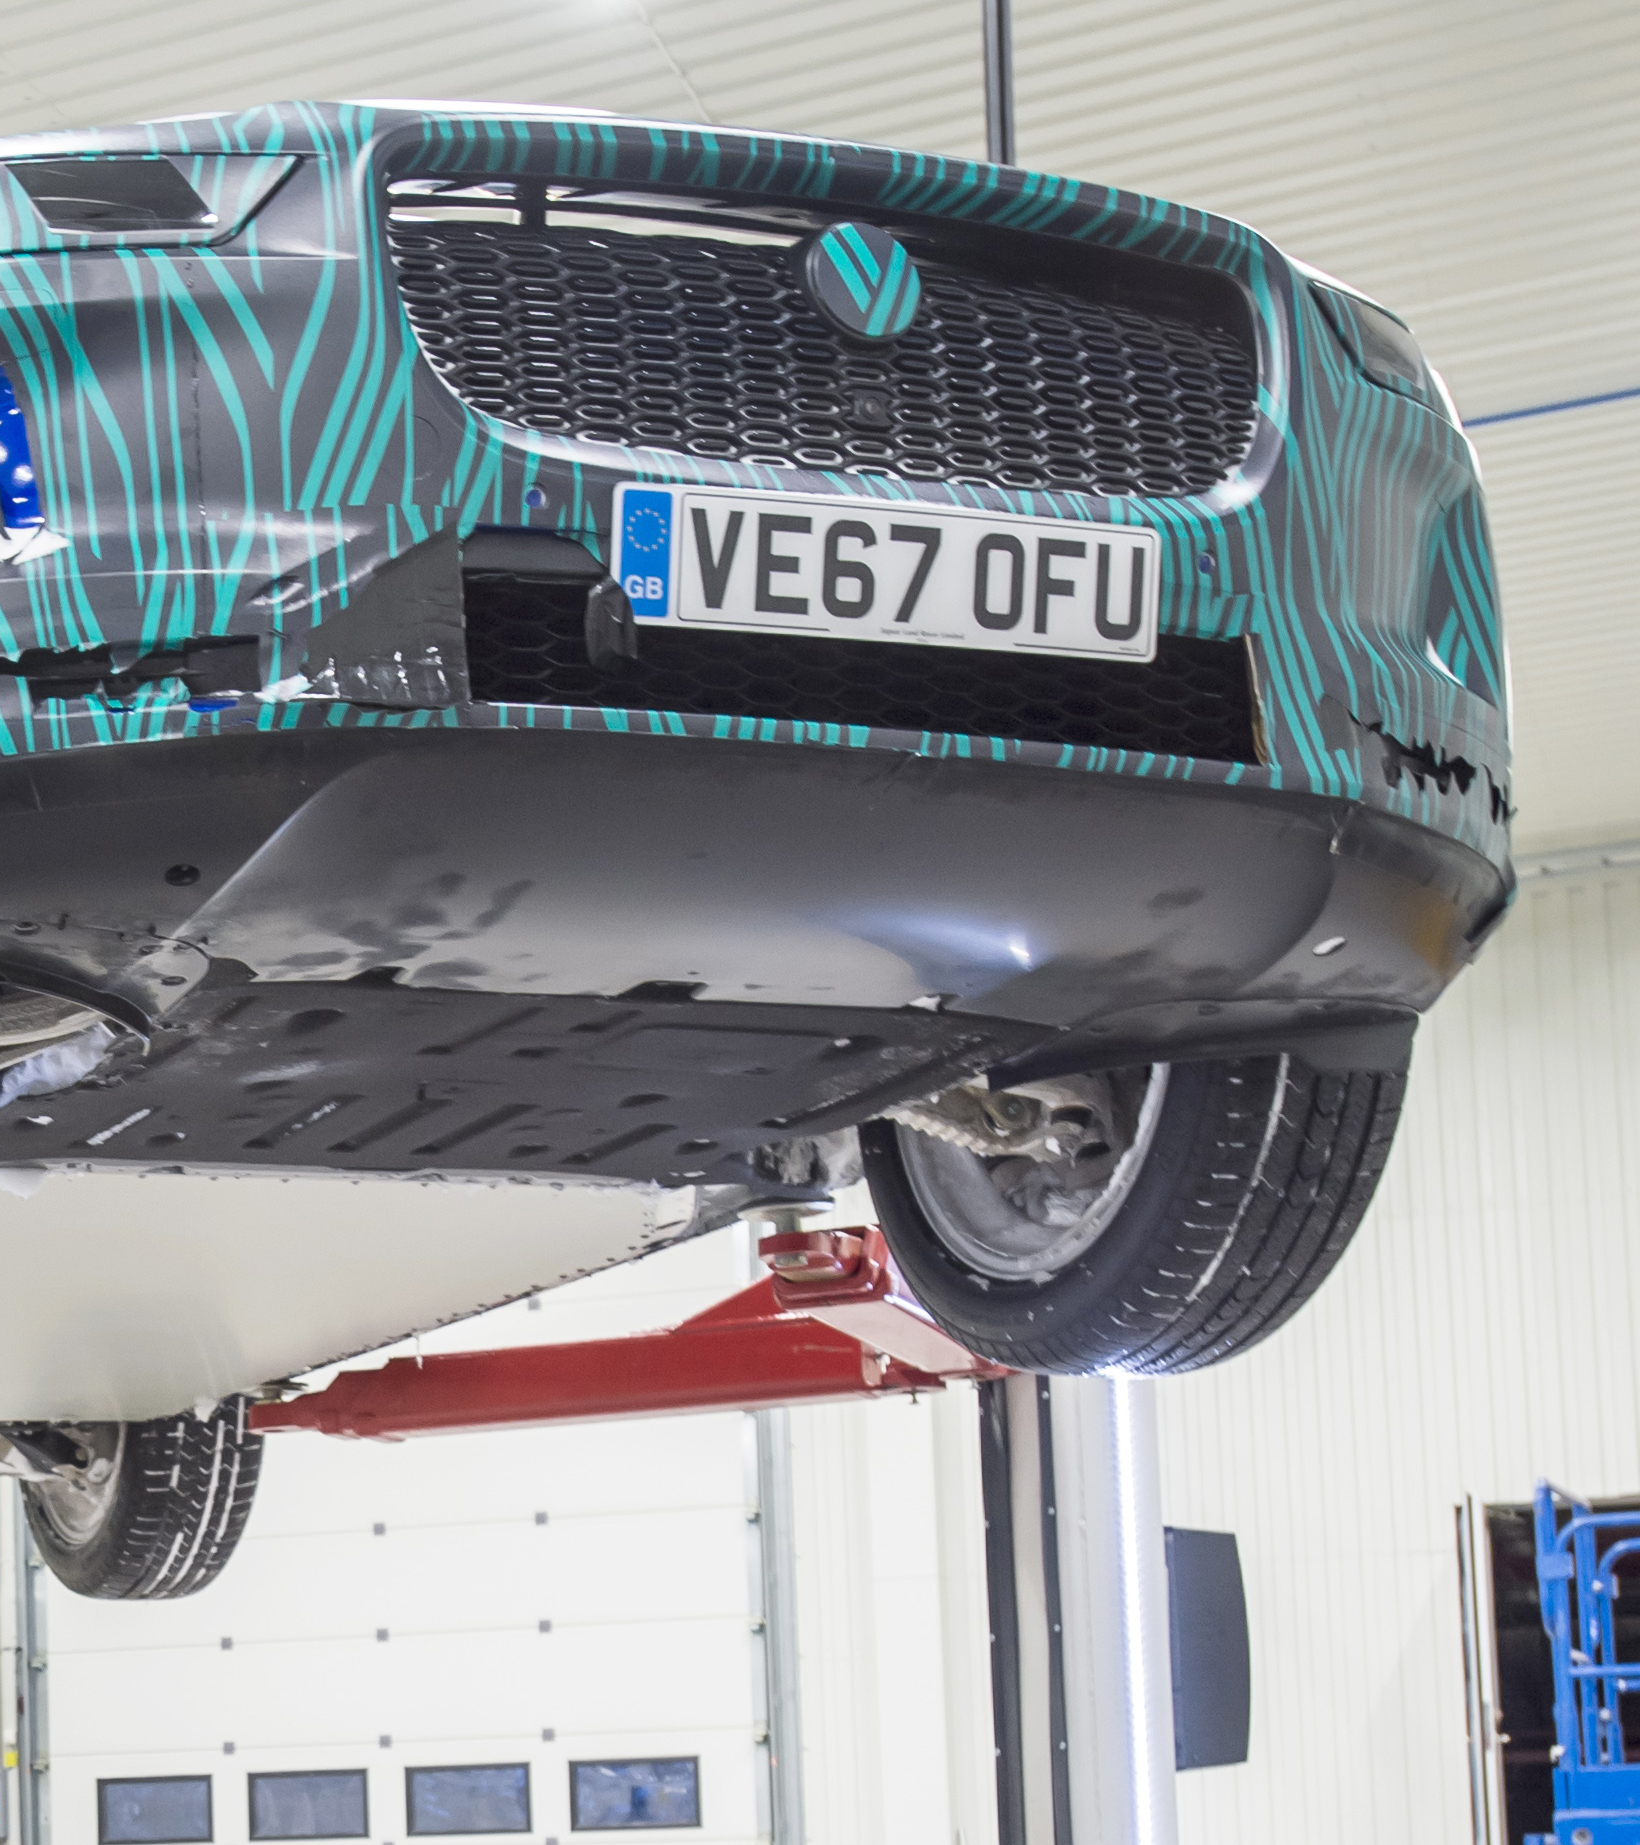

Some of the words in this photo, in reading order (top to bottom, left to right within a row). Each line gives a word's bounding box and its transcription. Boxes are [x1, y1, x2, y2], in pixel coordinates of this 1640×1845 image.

[624, 574, 665, 601] GB
[689, 507, 943, 624] VE67
[973, 532, 1146, 641] OFU
